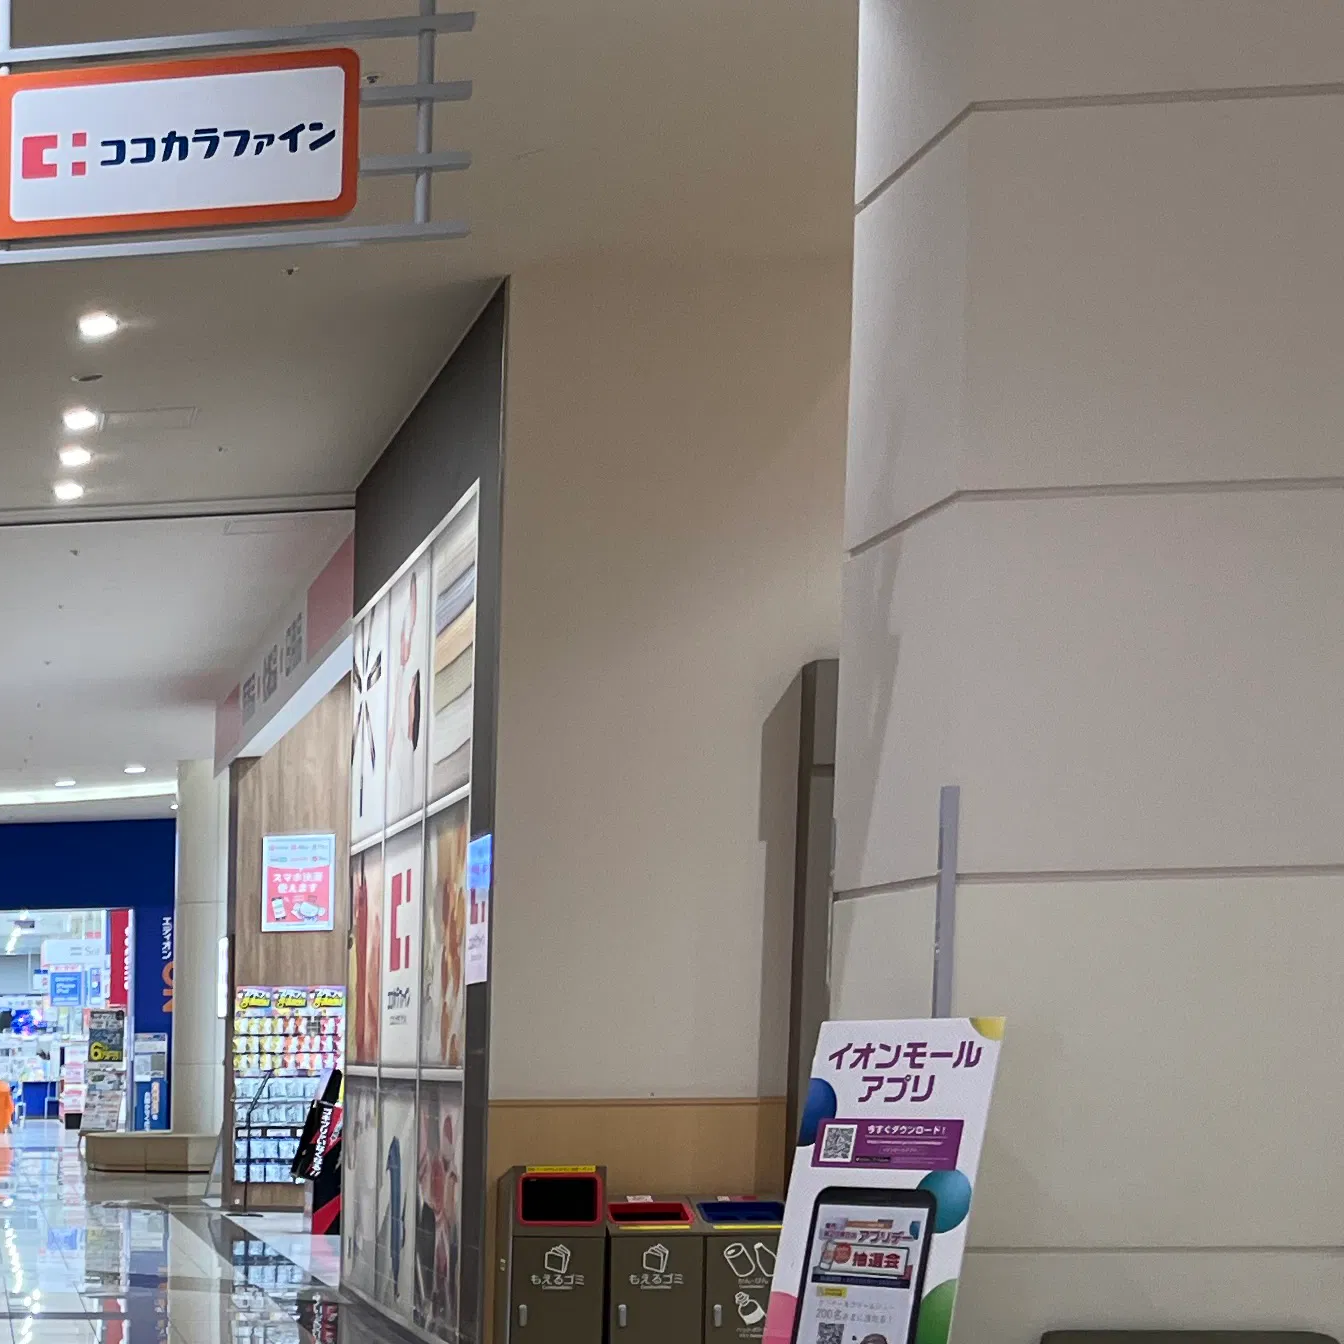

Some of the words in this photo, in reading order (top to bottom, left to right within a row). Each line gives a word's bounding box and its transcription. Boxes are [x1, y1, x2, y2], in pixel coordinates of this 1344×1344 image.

[98, 120, 338, 168] ココカラファイン
[828, 1040, 983, 1070] イオンモール
[857, 1074, 936, 1103] アプリ
[852, 1250, 901, 1270] 抽選会
[530, 1273, 585, 1286] もえるゴミ
[628, 1273, 684, 1285] もえるゴミ
